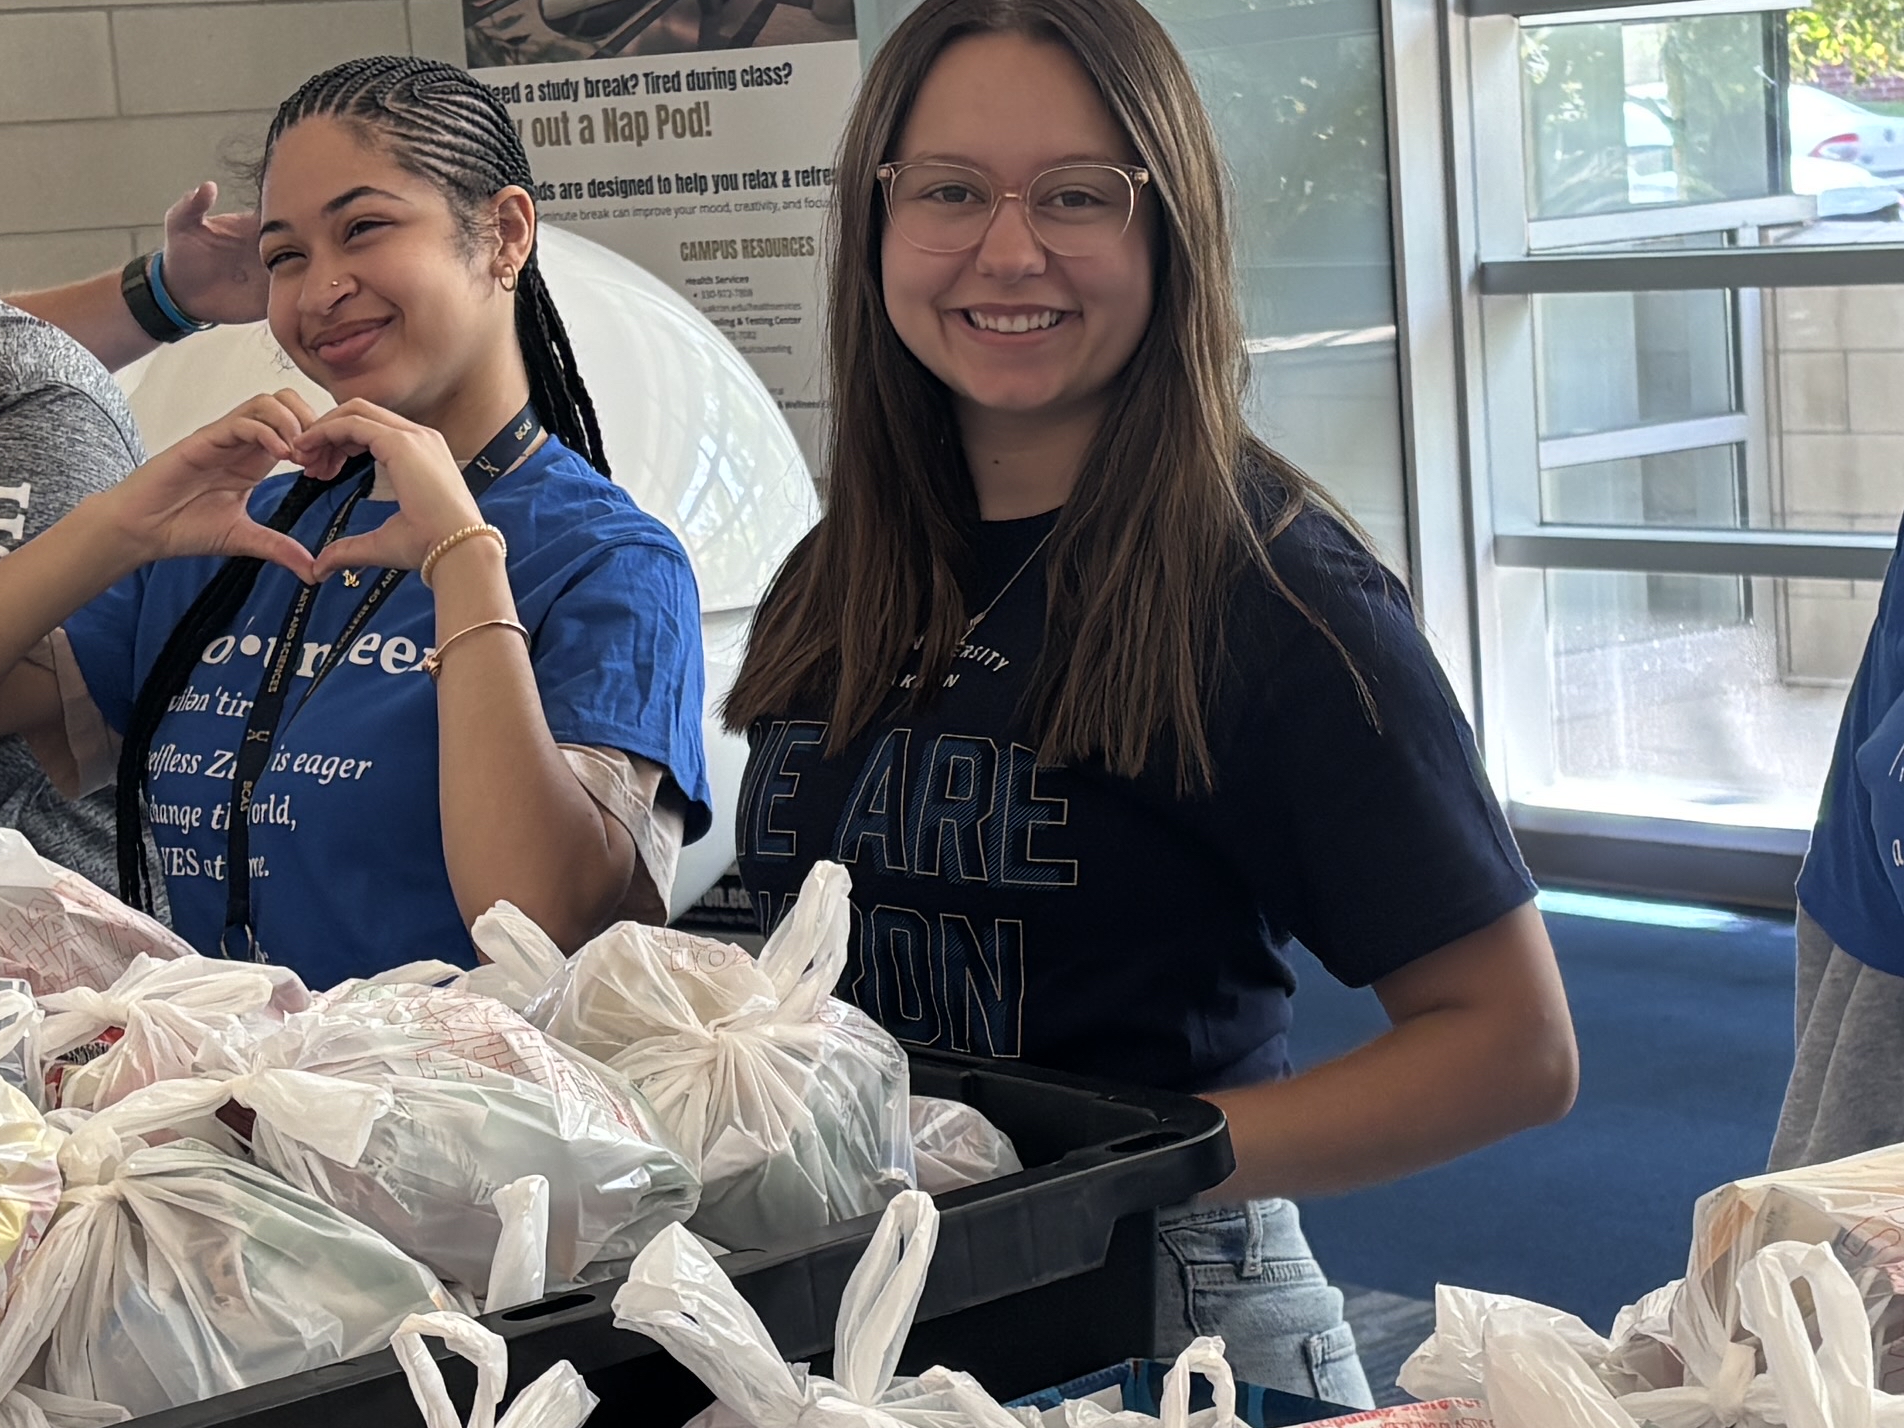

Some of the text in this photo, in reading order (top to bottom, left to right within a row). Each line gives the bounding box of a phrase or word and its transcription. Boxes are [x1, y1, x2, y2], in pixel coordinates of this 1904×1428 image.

[525, 84, 535, 102] a
[538, 79, 579, 105] study
[584, 72, 639, 98] break?
[643, 70, 681, 96] Tired
[686, 66, 737, 93] during
[741, 62, 793, 88] class?
[532, 110, 571, 148] out
[578, 113, 594, 145] a
[602, 106, 649, 147] Nap
[655, 100, 712, 139] Pod!
[559, 181, 583, 199] are
[588, 175, 653, 200] designed
[657, 175, 672, 195] to
[675, 172, 708, 196] help
[711, 174, 739, 195] you
[743, 168, 779, 191] relax
[782, 169, 791, 188] &
[581, 207, 609, 220] break
[612, 208, 630, 219] can
[632, 206, 672, 220] improve
[674, 204, 698, 219] your
[700, 201, 731, 215] mood,
[782, 197, 802, 210] and
[680, 236, 815, 261] CAMPUS RESOURCES
[148, 744, 373, 785] elfless is eager
[246, 793, 297, 832] orld,
[834, 728, 1080, 887] ARE
[161, 847, 227, 881] YES at
[1892, 839, 1904, 866] a
